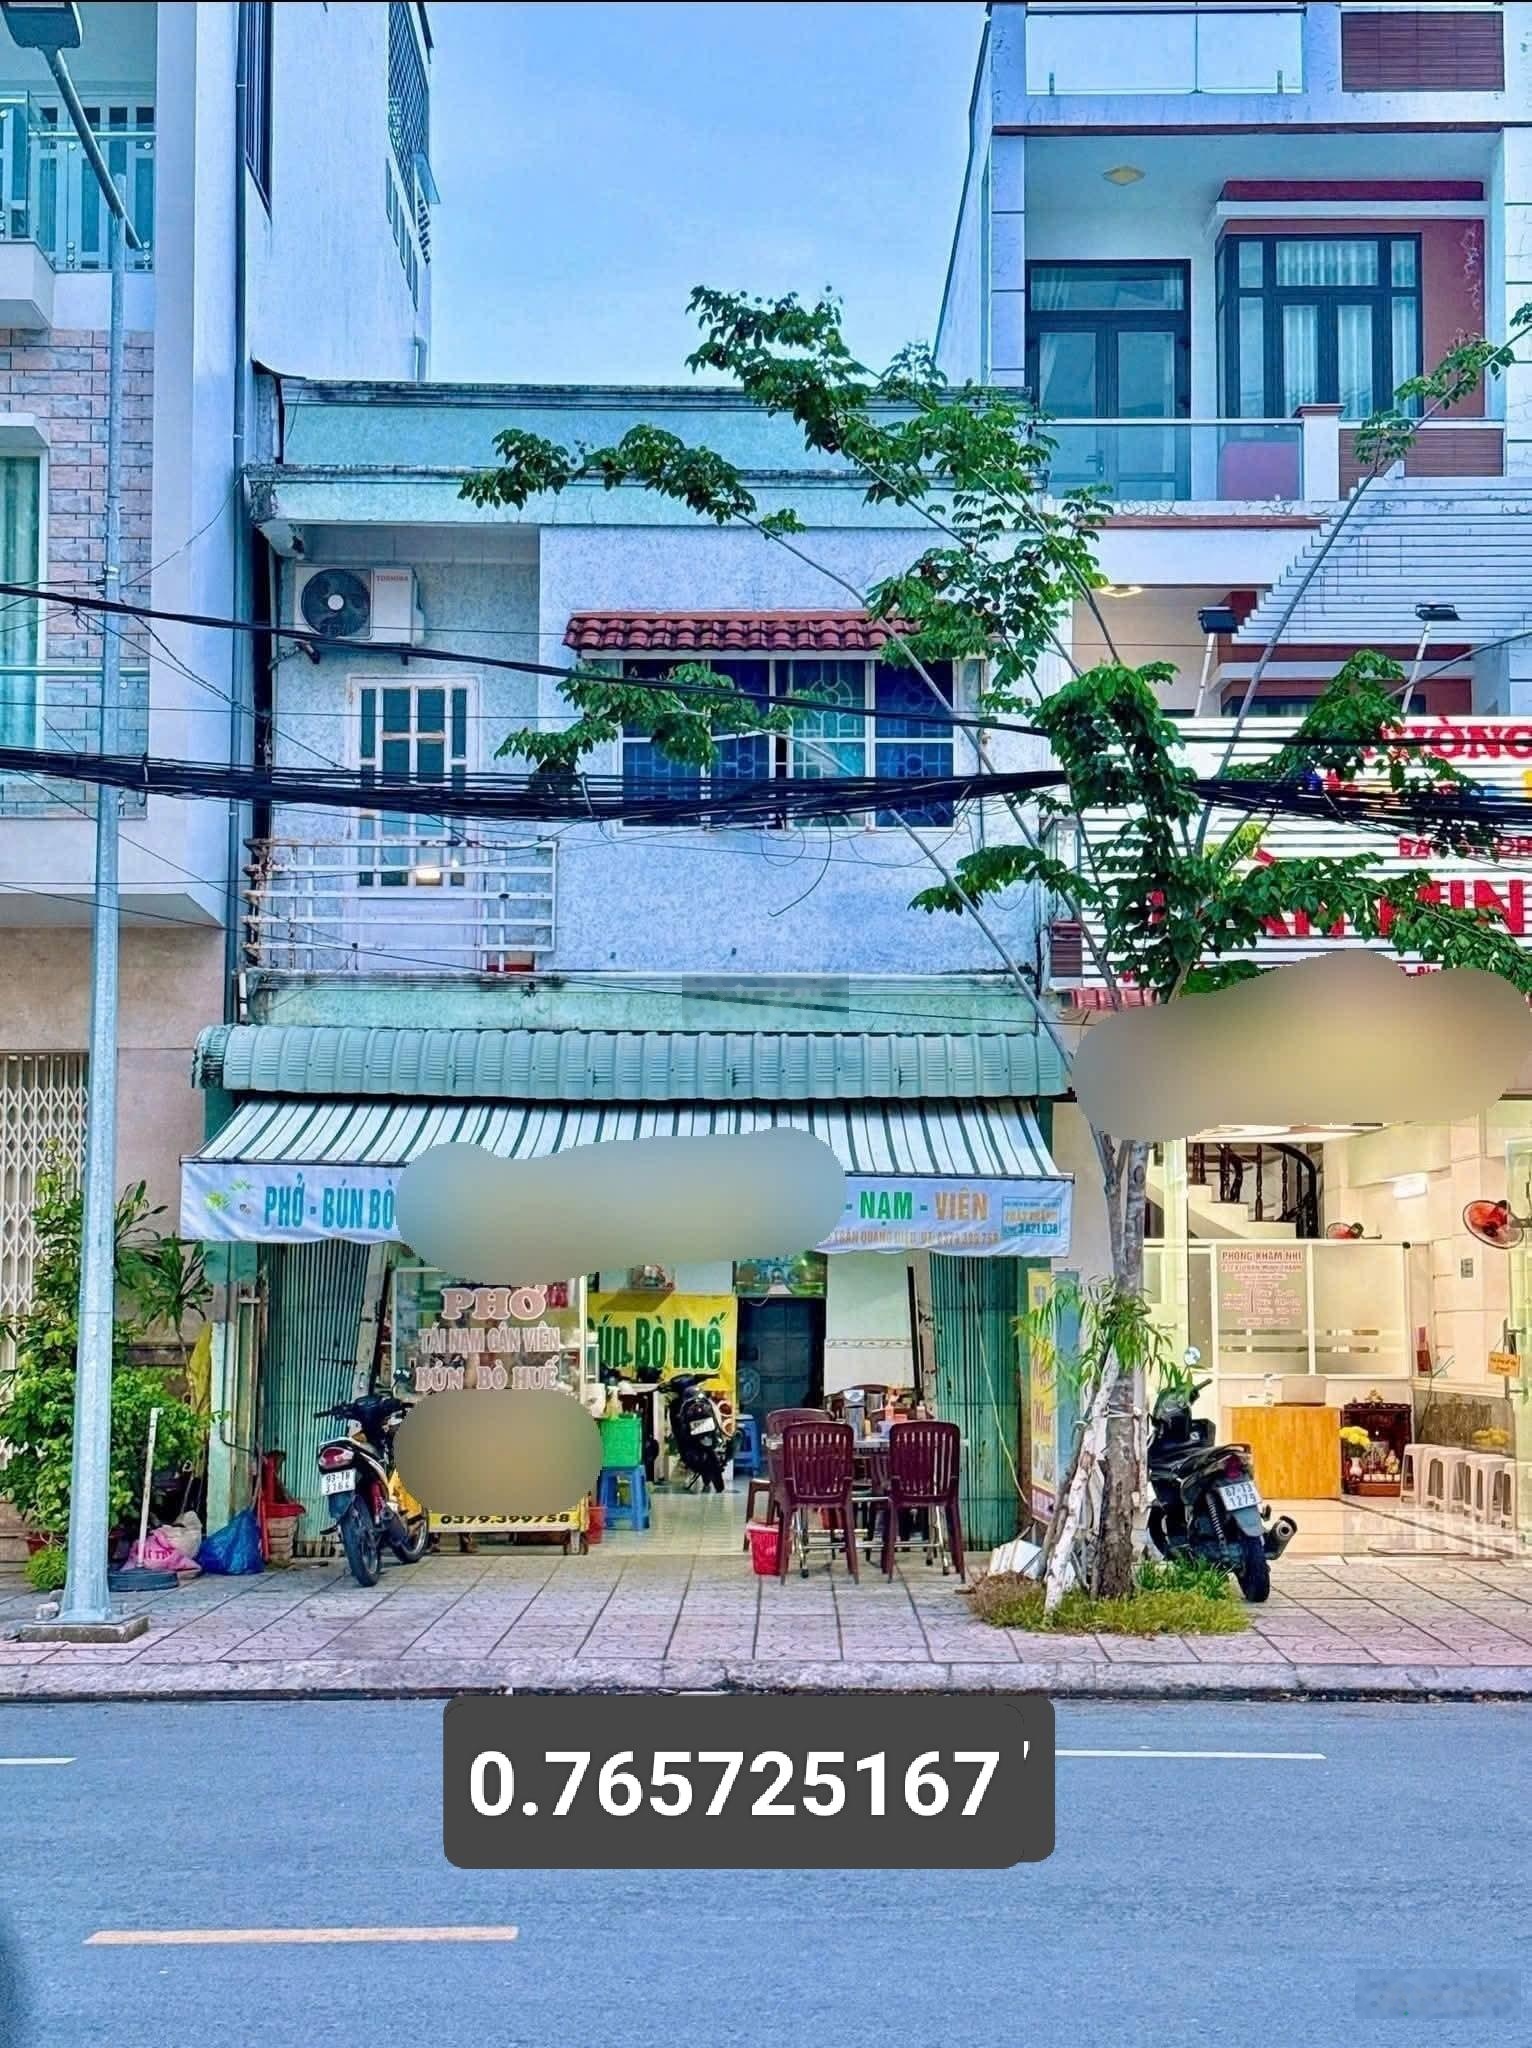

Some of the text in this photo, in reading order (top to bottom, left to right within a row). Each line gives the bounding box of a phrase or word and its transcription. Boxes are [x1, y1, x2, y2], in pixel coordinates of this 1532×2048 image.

[264, 1172, 305, 1228] PHỞ
[323, 1179, 363, 1229] BÚN
[368, 1179, 395, 1230] BÒ
[860, 1191, 913, 1226] NẠM
[935, 1184, 989, 1221] VIÊN
[522, 1321, 561, 1353] VIÊN
[587, 1312, 728, 1371] ún Bò Huế
[415, 1355, 560, 1391] BÚN BÒ HUẾ
[440, 1513, 570, 1525] 0379.399758
